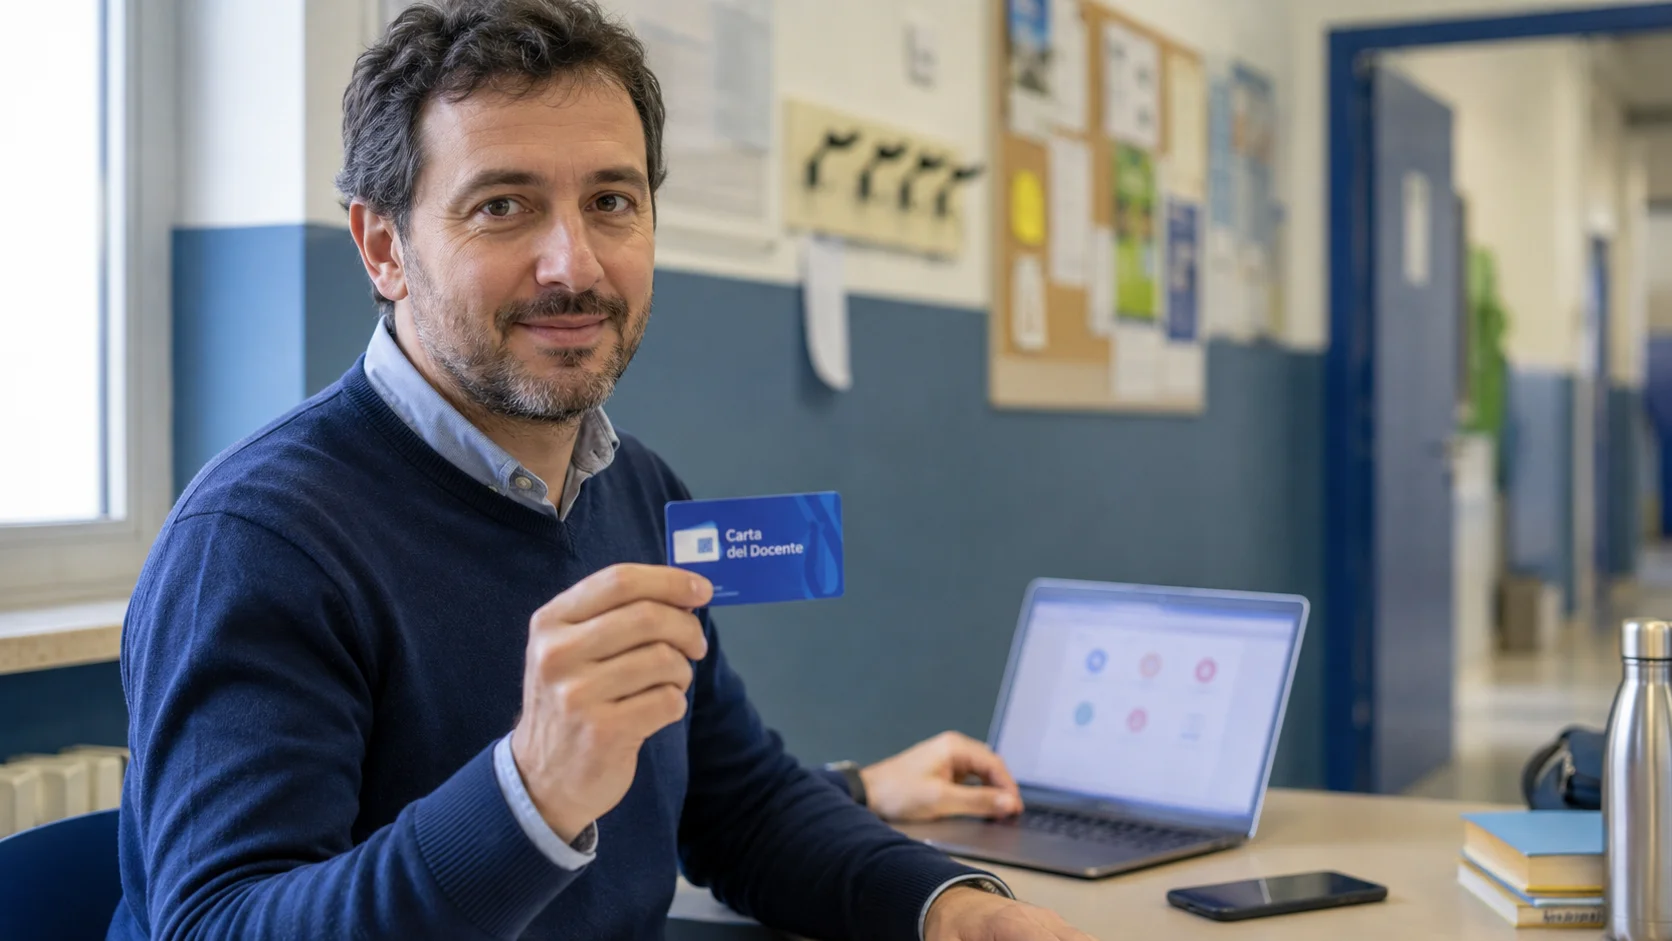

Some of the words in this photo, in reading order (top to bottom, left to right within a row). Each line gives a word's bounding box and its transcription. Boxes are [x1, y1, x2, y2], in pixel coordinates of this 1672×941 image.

[726, 529, 762, 542] Carta
[727, 545, 747, 559] del
[750, 543, 803, 557] Docente
